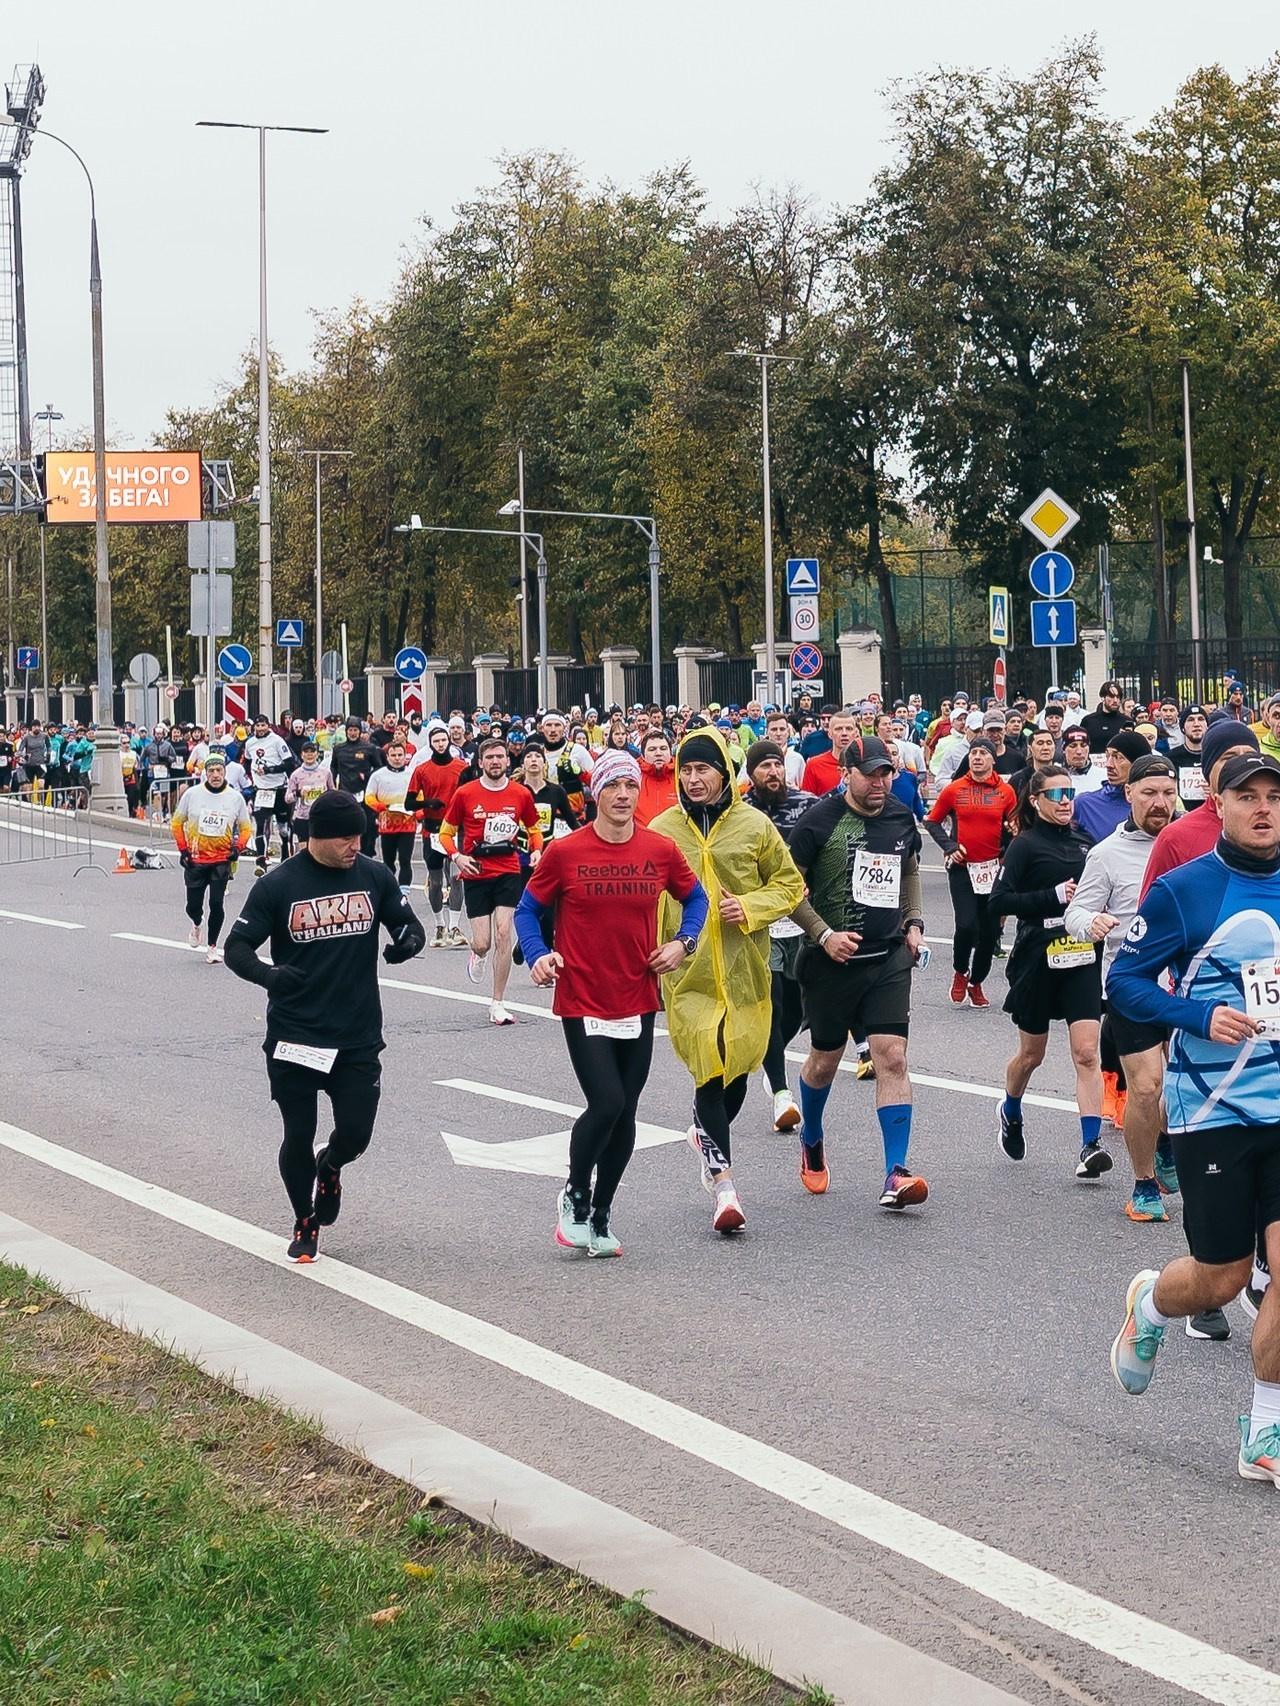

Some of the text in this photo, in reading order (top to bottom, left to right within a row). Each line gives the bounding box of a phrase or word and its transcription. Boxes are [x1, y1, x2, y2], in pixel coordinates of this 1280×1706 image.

[799, 614, 811, 624] 30
[202, 815, 224, 827] 4841
[487, 820, 518, 836] 16037
[577, 863, 639, 878] Reebok
[859, 866, 894, 885] 7984
[584, 882, 657, 896] TRAINING
[290, 893, 373, 931] AKA
[292, 920, 371, 940] THAILAND
[1052, 955, 1060, 964] G
[279, 1043, 287, 1054] G
